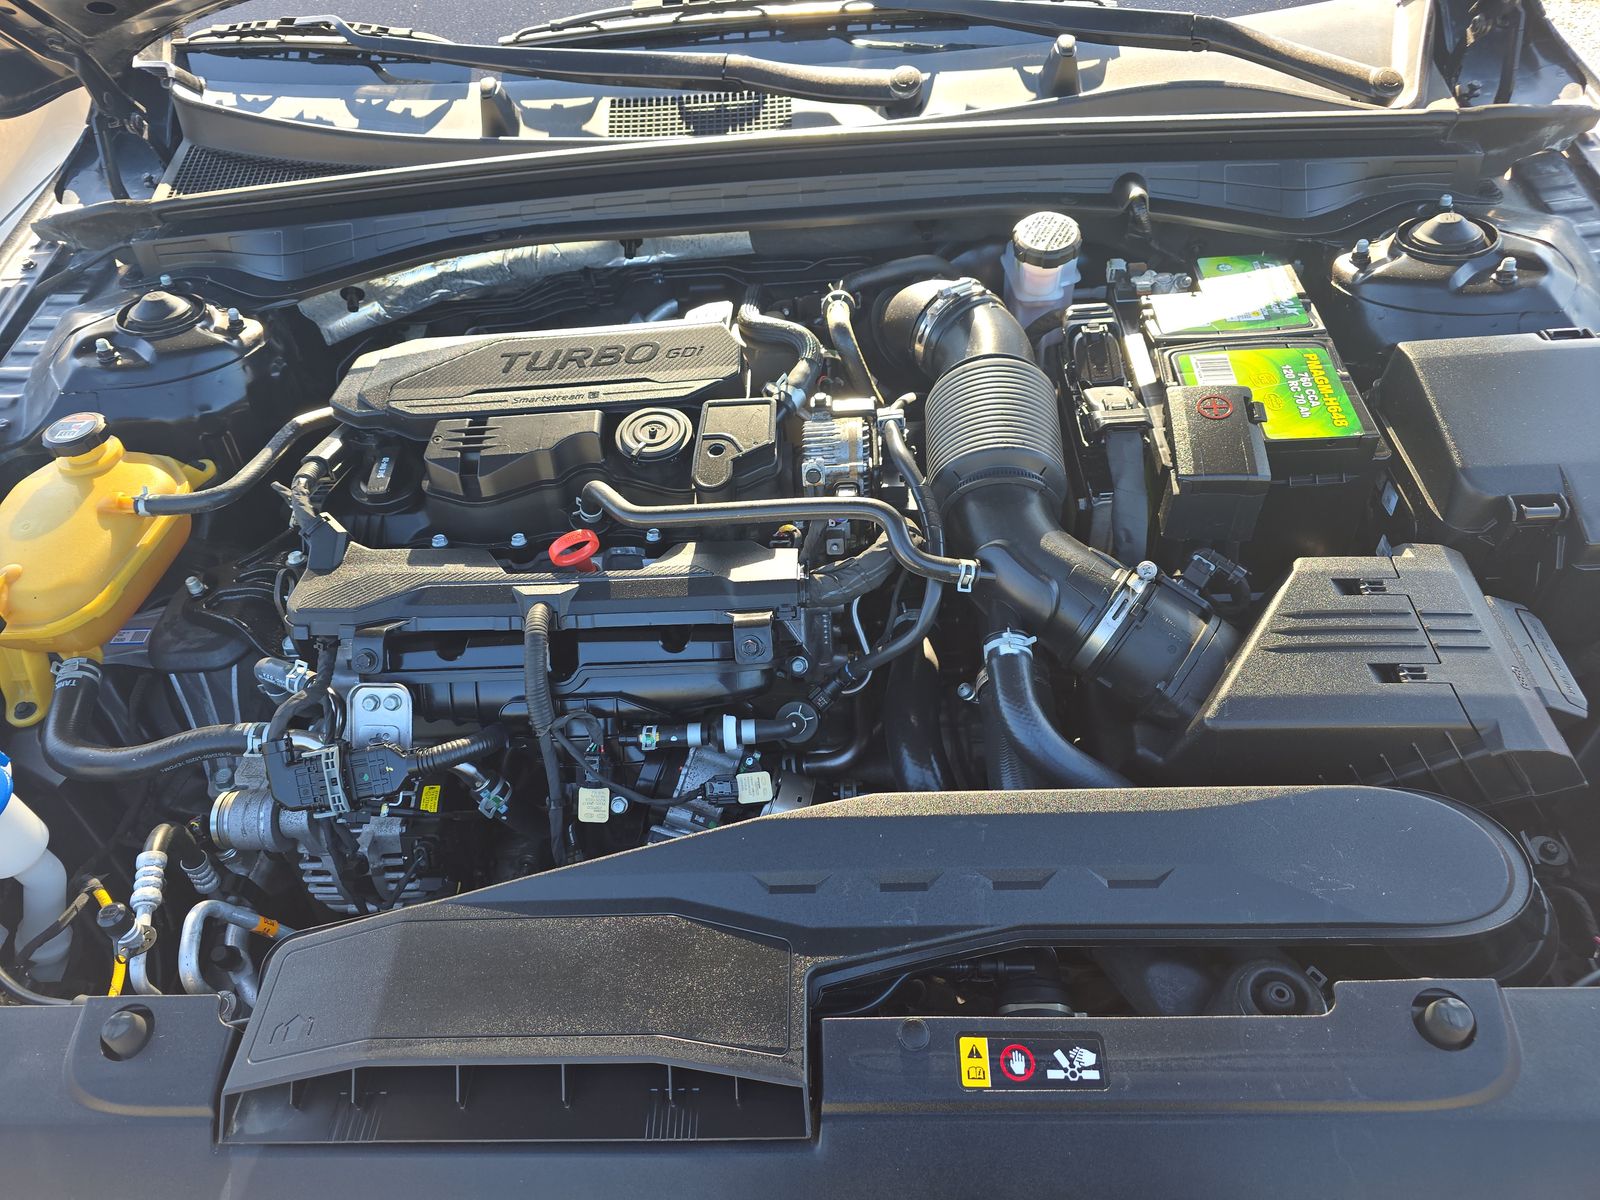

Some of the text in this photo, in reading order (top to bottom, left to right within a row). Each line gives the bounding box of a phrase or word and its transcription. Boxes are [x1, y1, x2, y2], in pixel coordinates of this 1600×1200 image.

[501, 341, 704, 374] TURBO GDi
[511, 393, 585, 405] Smartstream
[1281, 364, 1312, 418] 120 RC 70 Ah
[1298, 372, 1321, 407] 760 CCA
